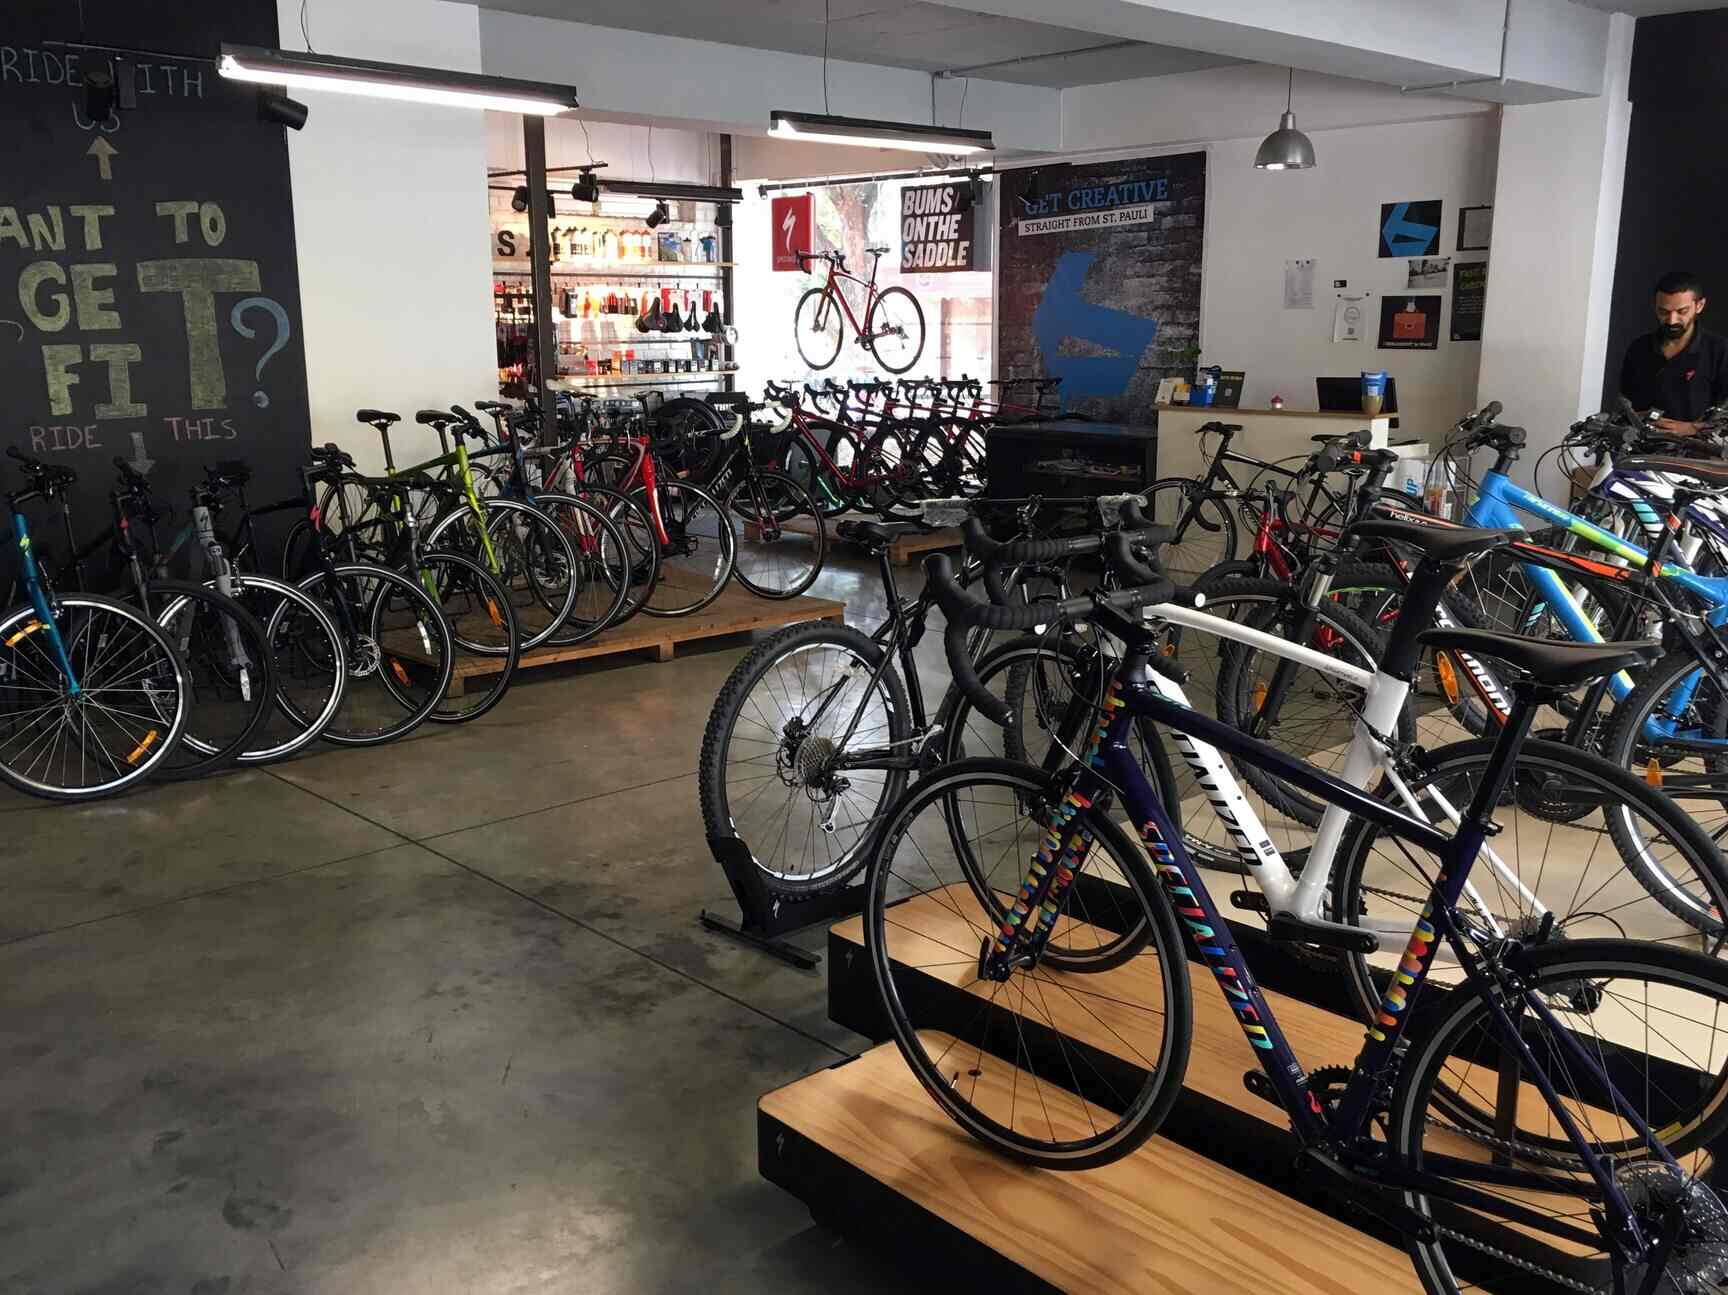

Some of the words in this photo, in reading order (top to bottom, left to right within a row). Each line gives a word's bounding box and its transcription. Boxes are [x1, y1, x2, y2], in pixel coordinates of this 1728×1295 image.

[1, 47, 83, 87] RIDE
[903, 187, 955, 216] BUMS
[1024, 192, 1062, 216] GET
[1068, 178, 1169, 209] CREATIVE
[155, 200, 227, 247] TO
[1024, 218, 1071, 233] STRAIGHT
[1072, 214, 1101, 228] FROM
[1102, 213, 1118, 225] ST.
[1119, 209, 1148, 223] PAULI
[903, 241, 970, 268] SADDLE
[29, 424, 102, 454] RIDE
[164, 416, 237, 443] THIS
[1169, 732, 1264, 866] CIALIZED
[1142, 820, 1274, 1051] SPECIALIZED
